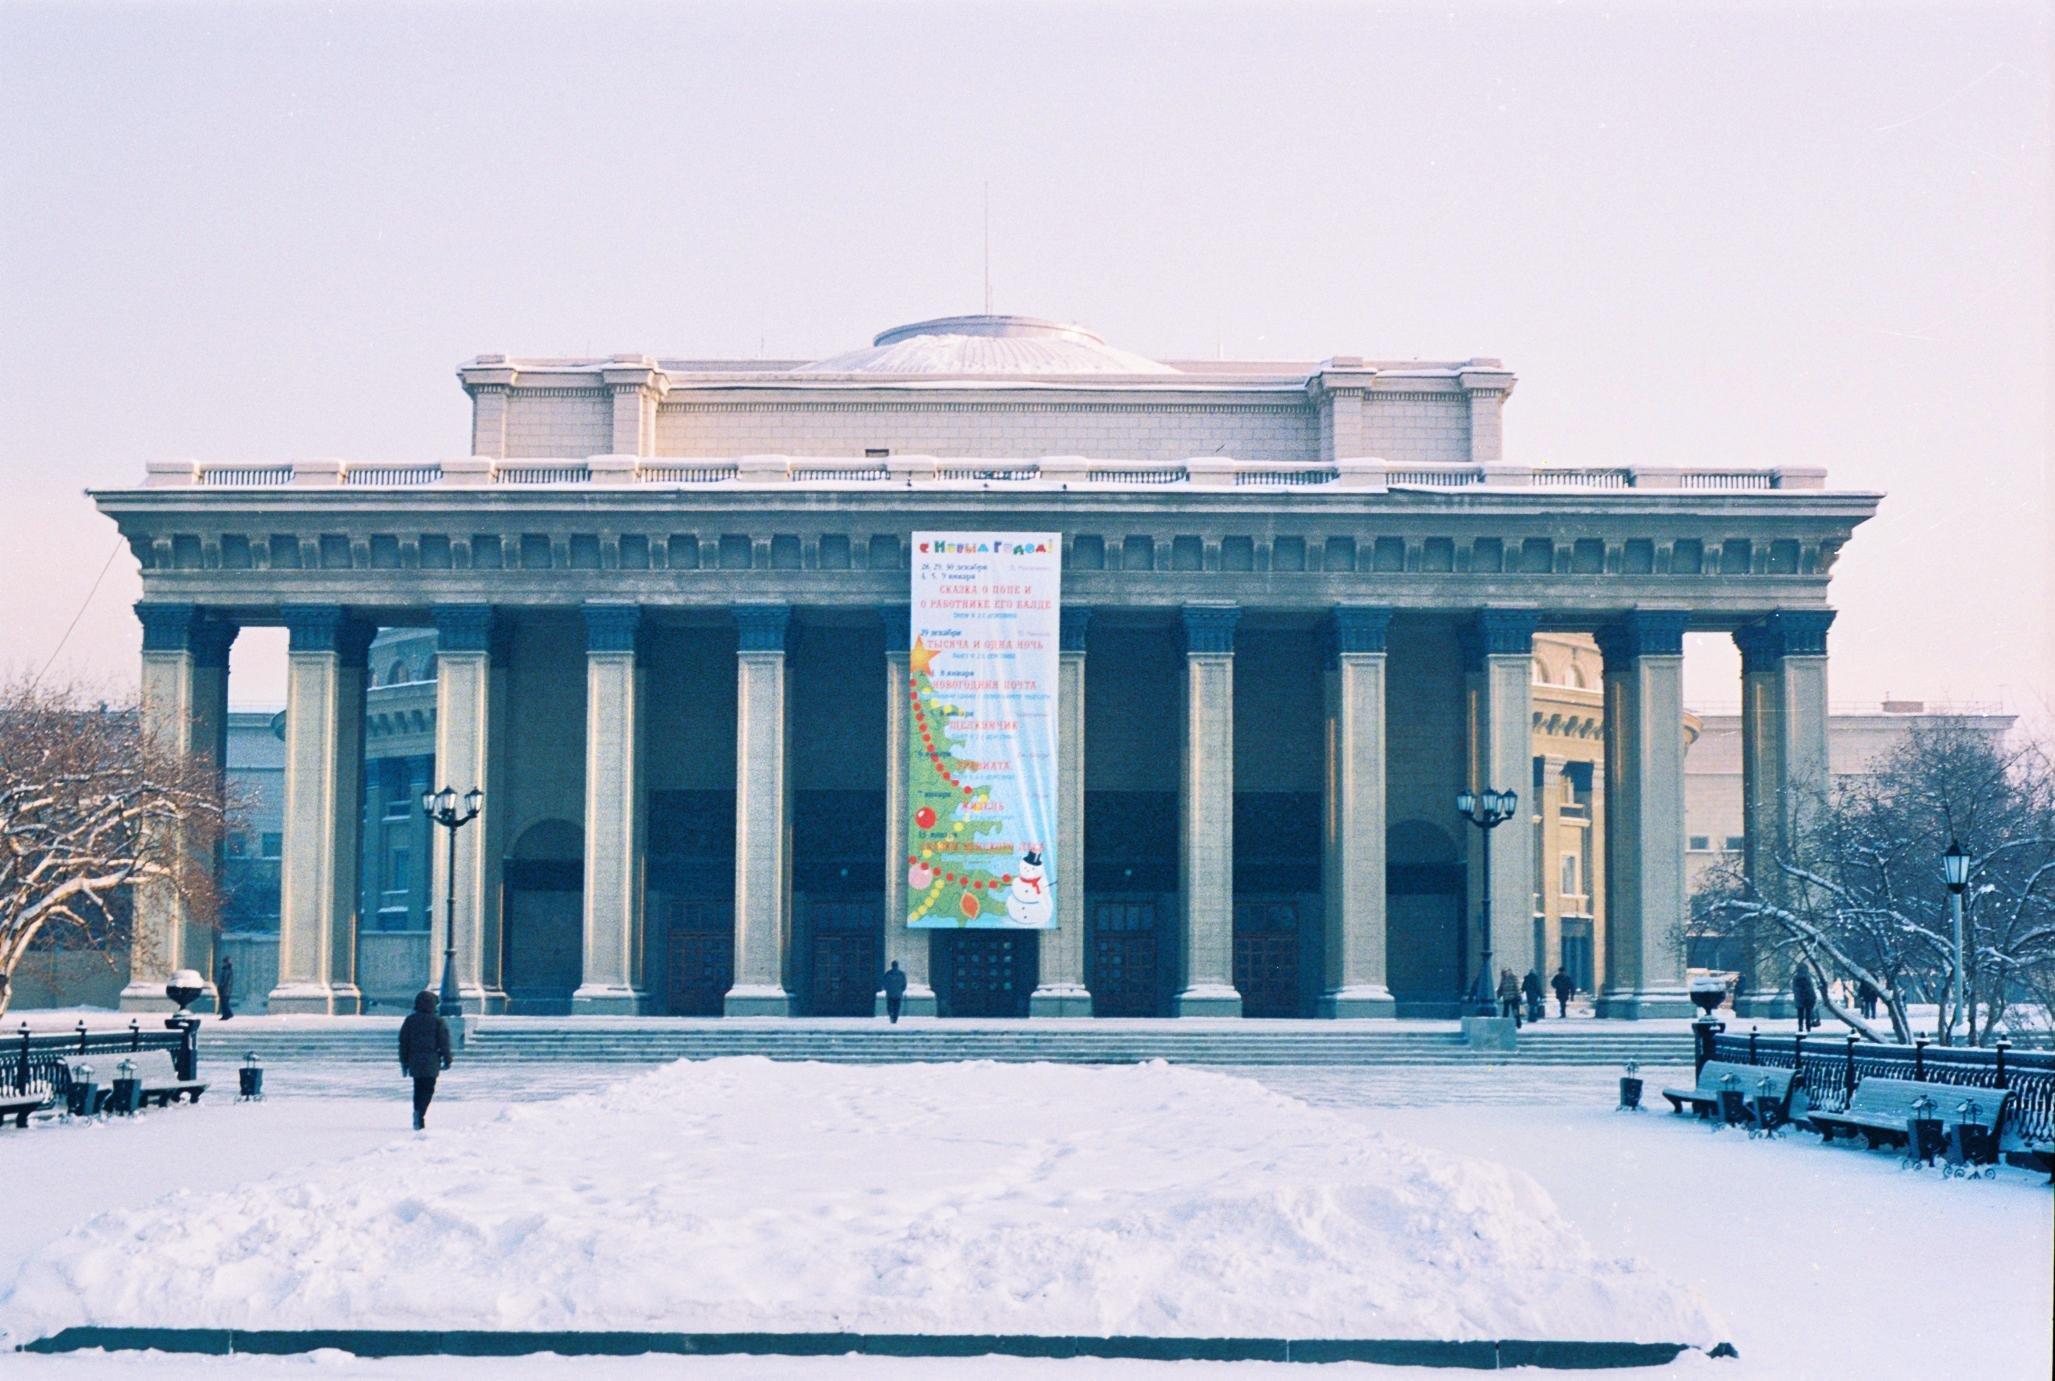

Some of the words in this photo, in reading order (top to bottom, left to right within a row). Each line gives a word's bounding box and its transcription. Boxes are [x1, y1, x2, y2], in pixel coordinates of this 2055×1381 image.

[939, 585, 977, 595] СКАЗКА
[983, 585, 989, 594] О
[992, 585, 1021, 595] ПОПЕ
[1024, 585, 1033, 594] И
[920, 600, 926, 609] О
[930, 600, 991, 609] РАБОТНИКЕ
[994, 600, 1013, 609] ЕГО
[1017, 600, 1052, 610] БАЛДЕ
[927, 640, 968, 649] ТЫСЯЧА
[973, 640, 980, 649] И
[984, 640, 1013, 650] ОДНА
[1017, 640, 1044, 649] НОЧЬ
[1004, 680, 1037, 690] ПОЧТА
